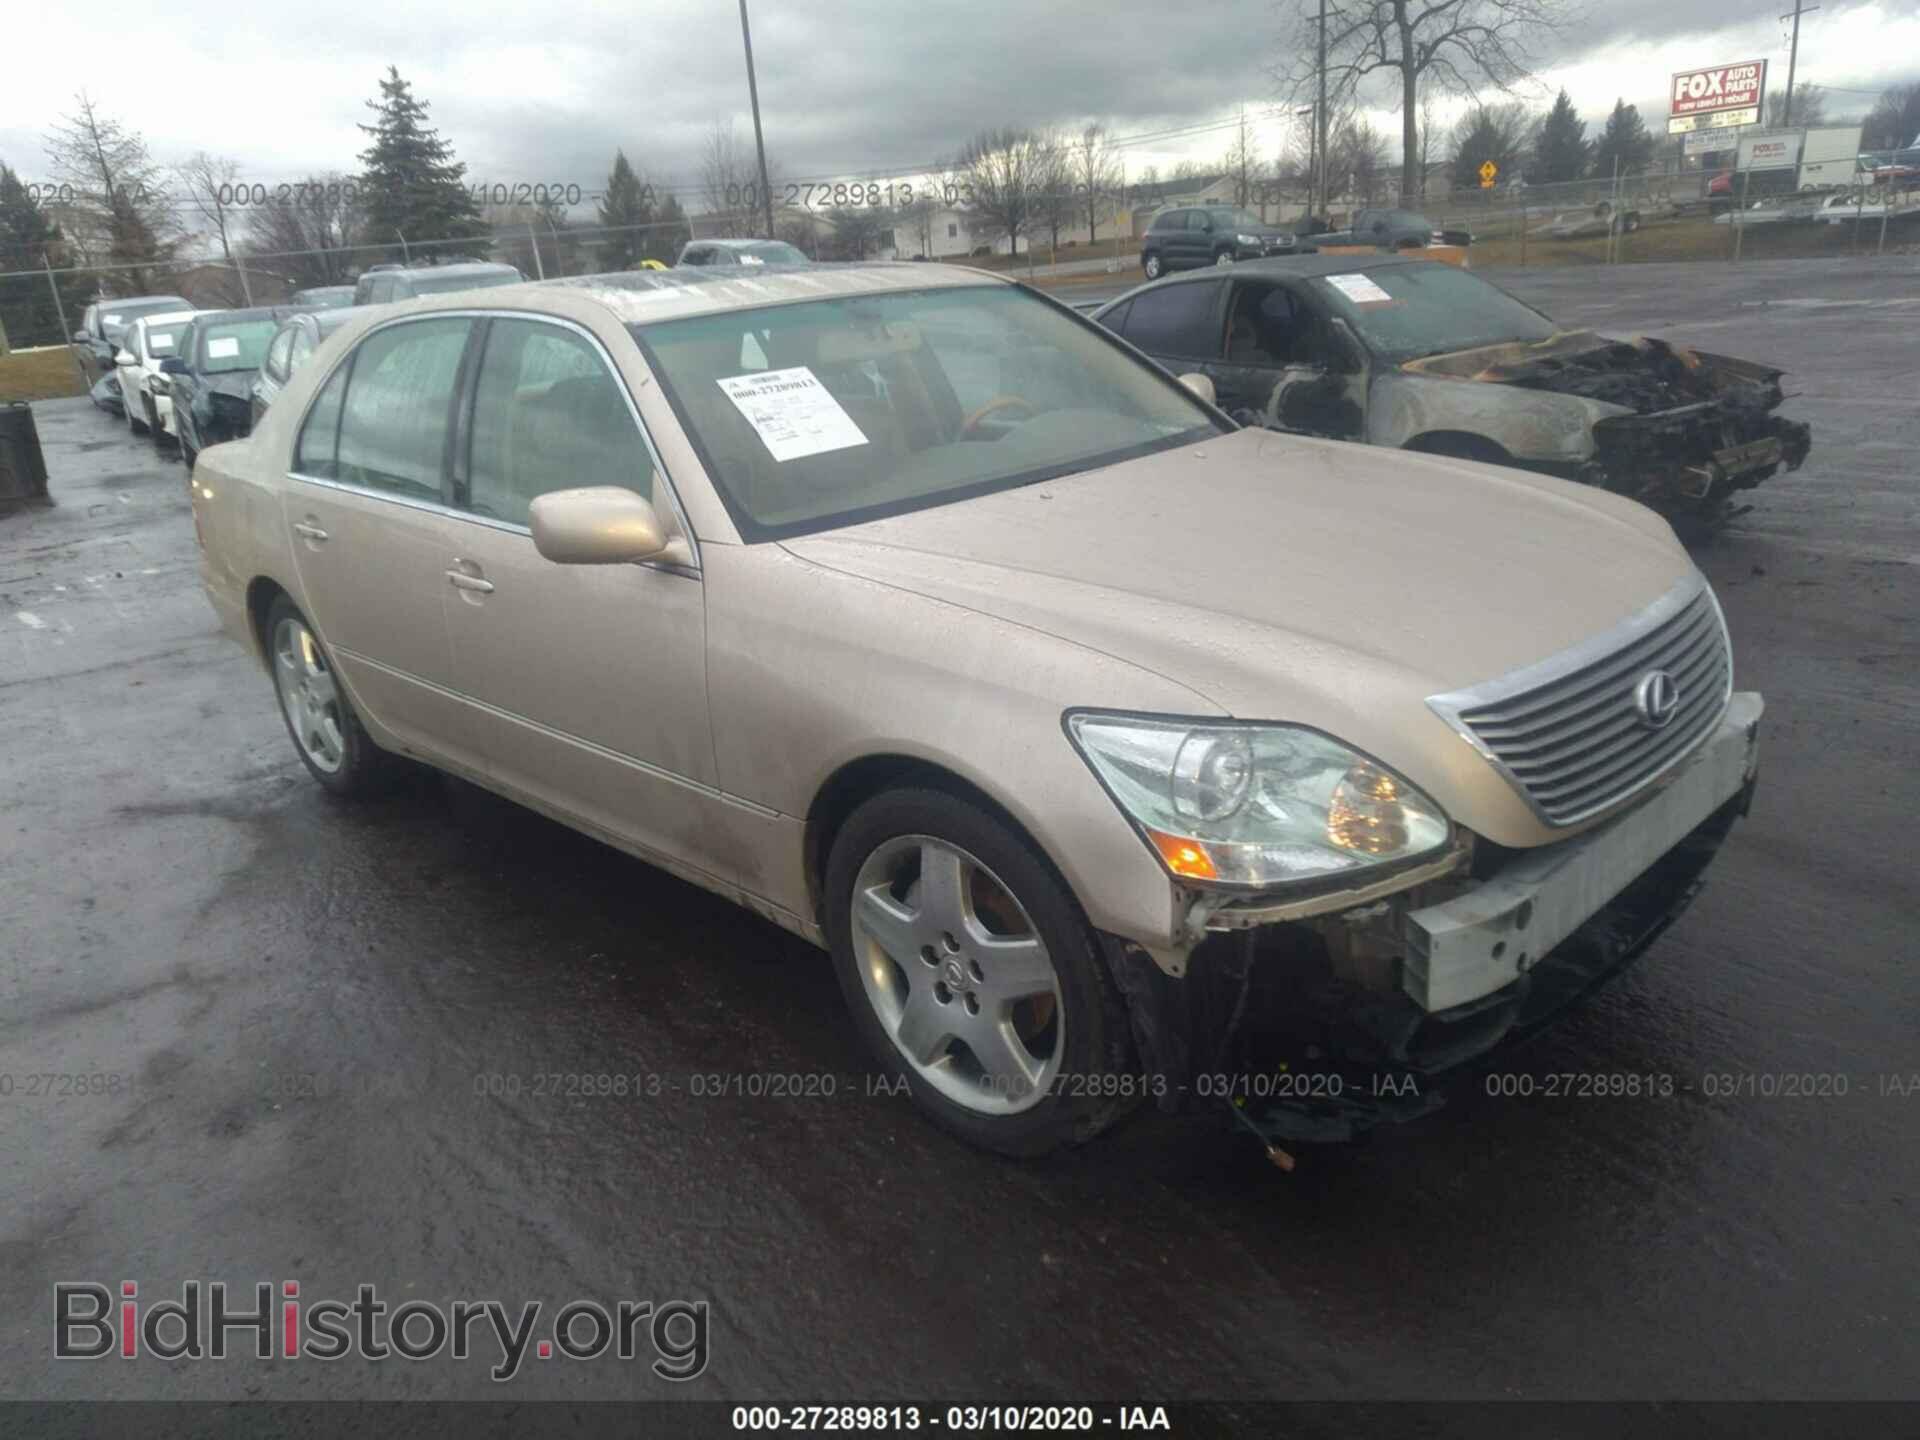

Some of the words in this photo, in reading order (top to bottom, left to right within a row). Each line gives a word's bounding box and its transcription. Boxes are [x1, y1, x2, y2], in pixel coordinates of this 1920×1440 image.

[1675, 71, 1725, 101] FOX
[1726, 66, 1755, 79] AUTO
[1726, 78, 1757, 92] PARTS
